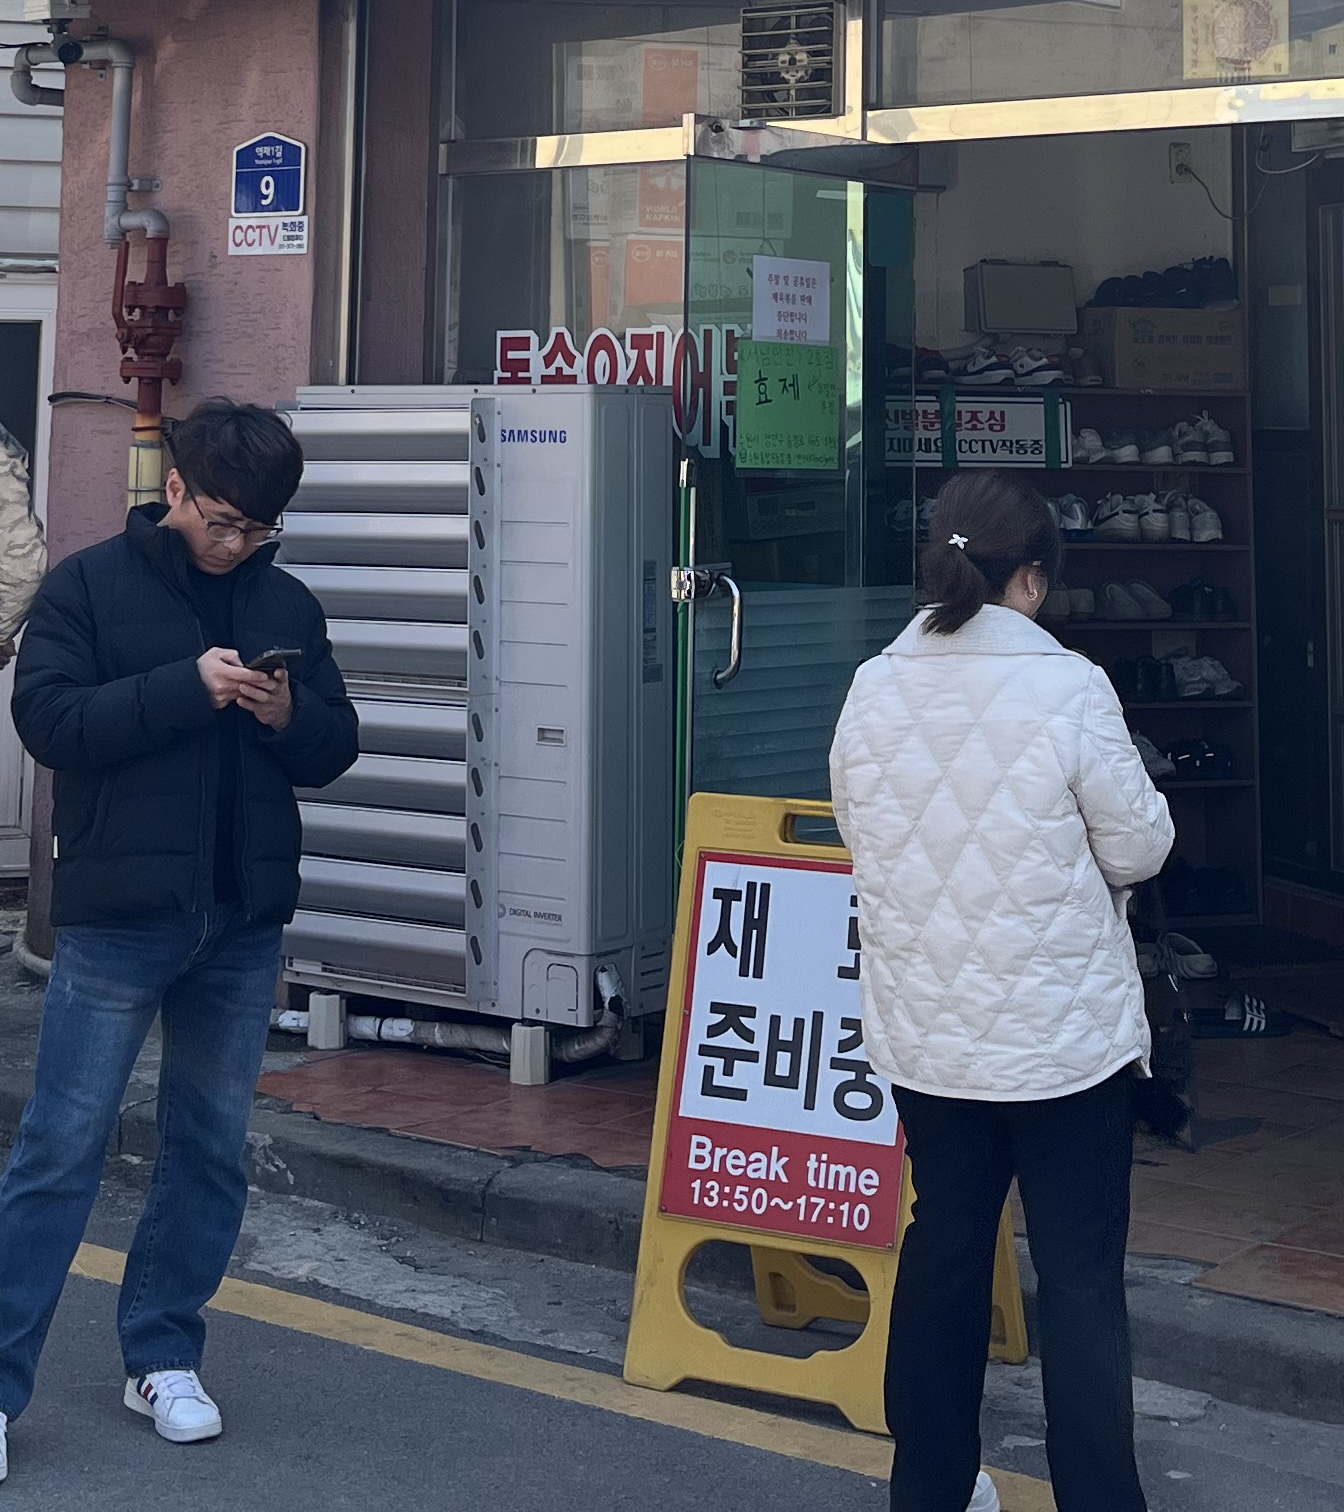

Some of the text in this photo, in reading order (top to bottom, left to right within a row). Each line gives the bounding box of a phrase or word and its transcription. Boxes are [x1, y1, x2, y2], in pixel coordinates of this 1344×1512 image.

[260, 175, 275, 206] 9
[232, 224, 279, 248] CCTV
[500, 428, 567, 445] SAMSUNG
[697, 1000, 885, 1123] 준비중
[688, 1135, 880, 1198] Break time
[690, 1177, 871, 1232] 13:50~17:10
